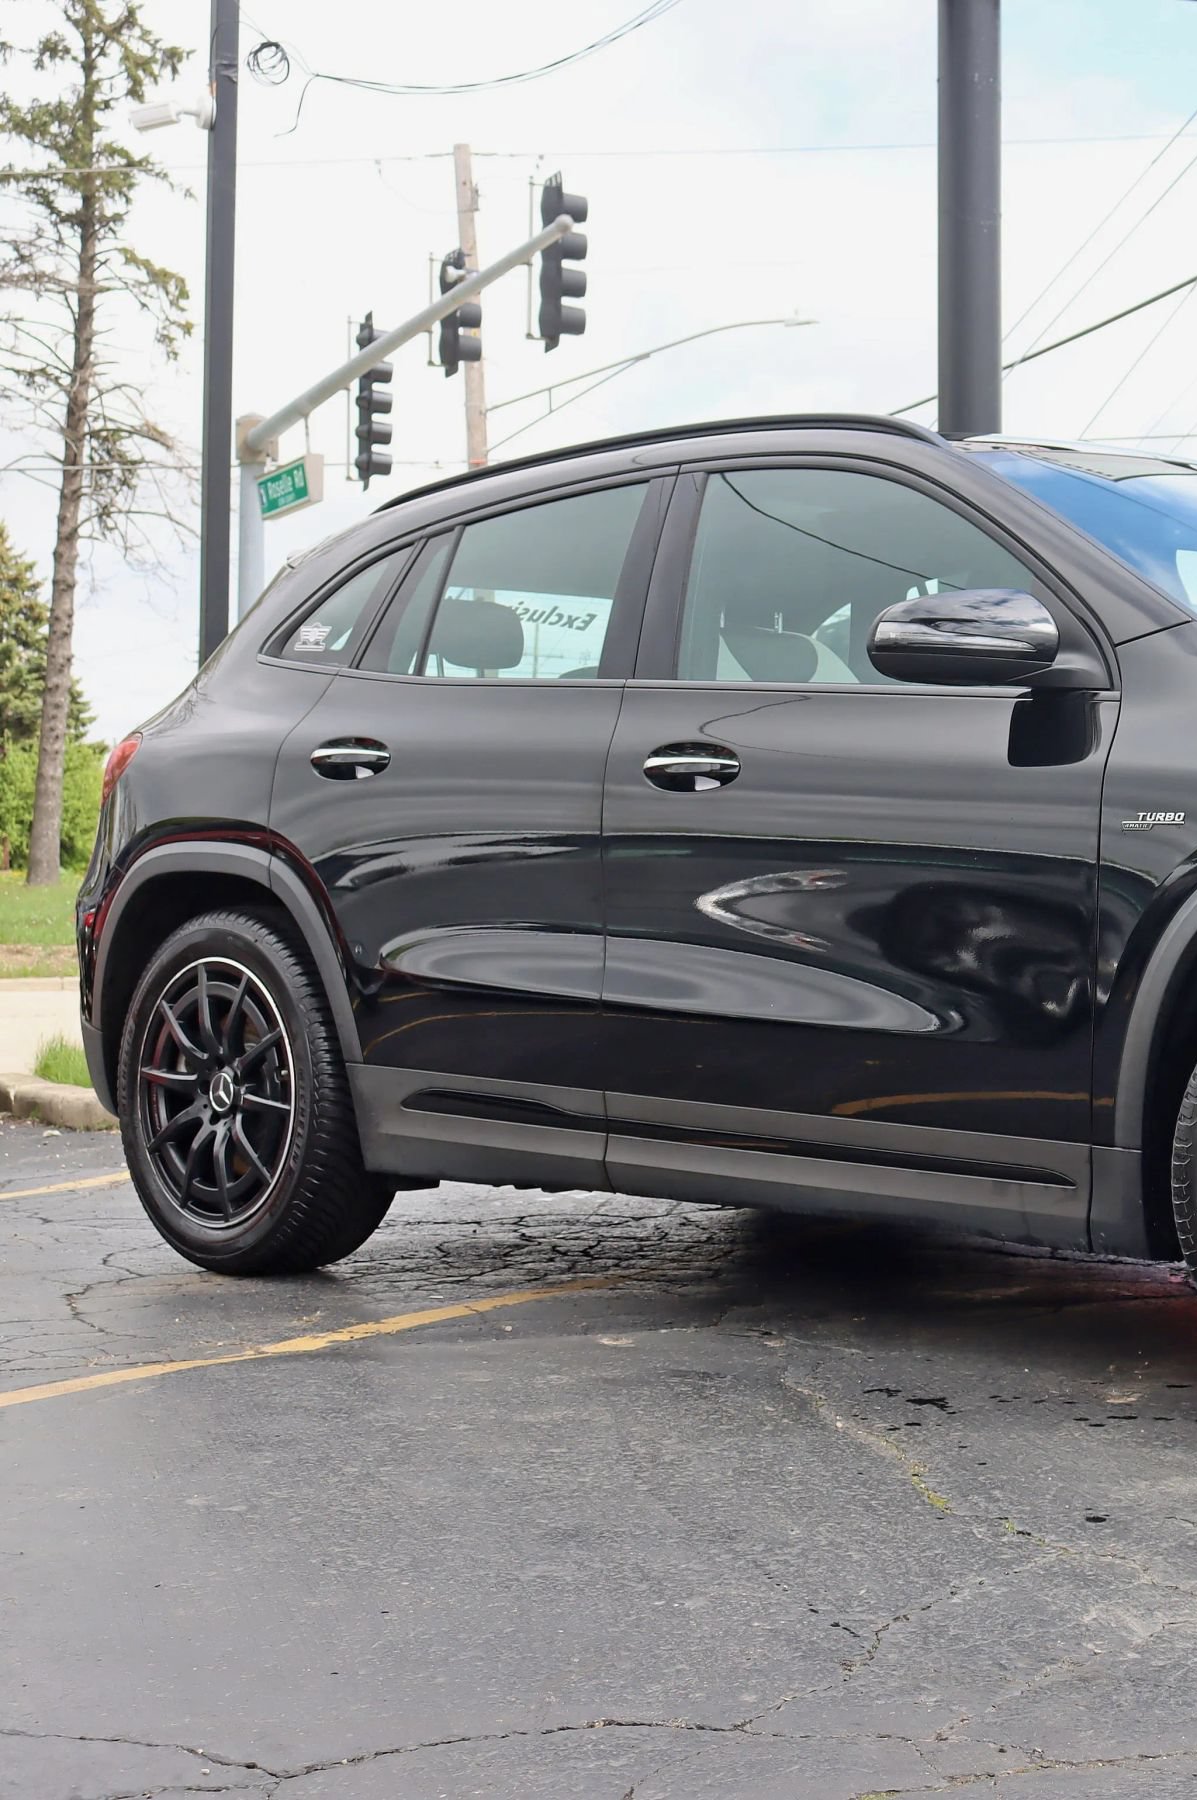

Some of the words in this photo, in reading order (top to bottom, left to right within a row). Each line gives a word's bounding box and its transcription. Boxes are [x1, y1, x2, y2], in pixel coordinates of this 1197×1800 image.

[268, 474, 293, 499] Roselle
[294, 466, 305, 489] Rd
[1137, 812, 1185, 822] TURBO
